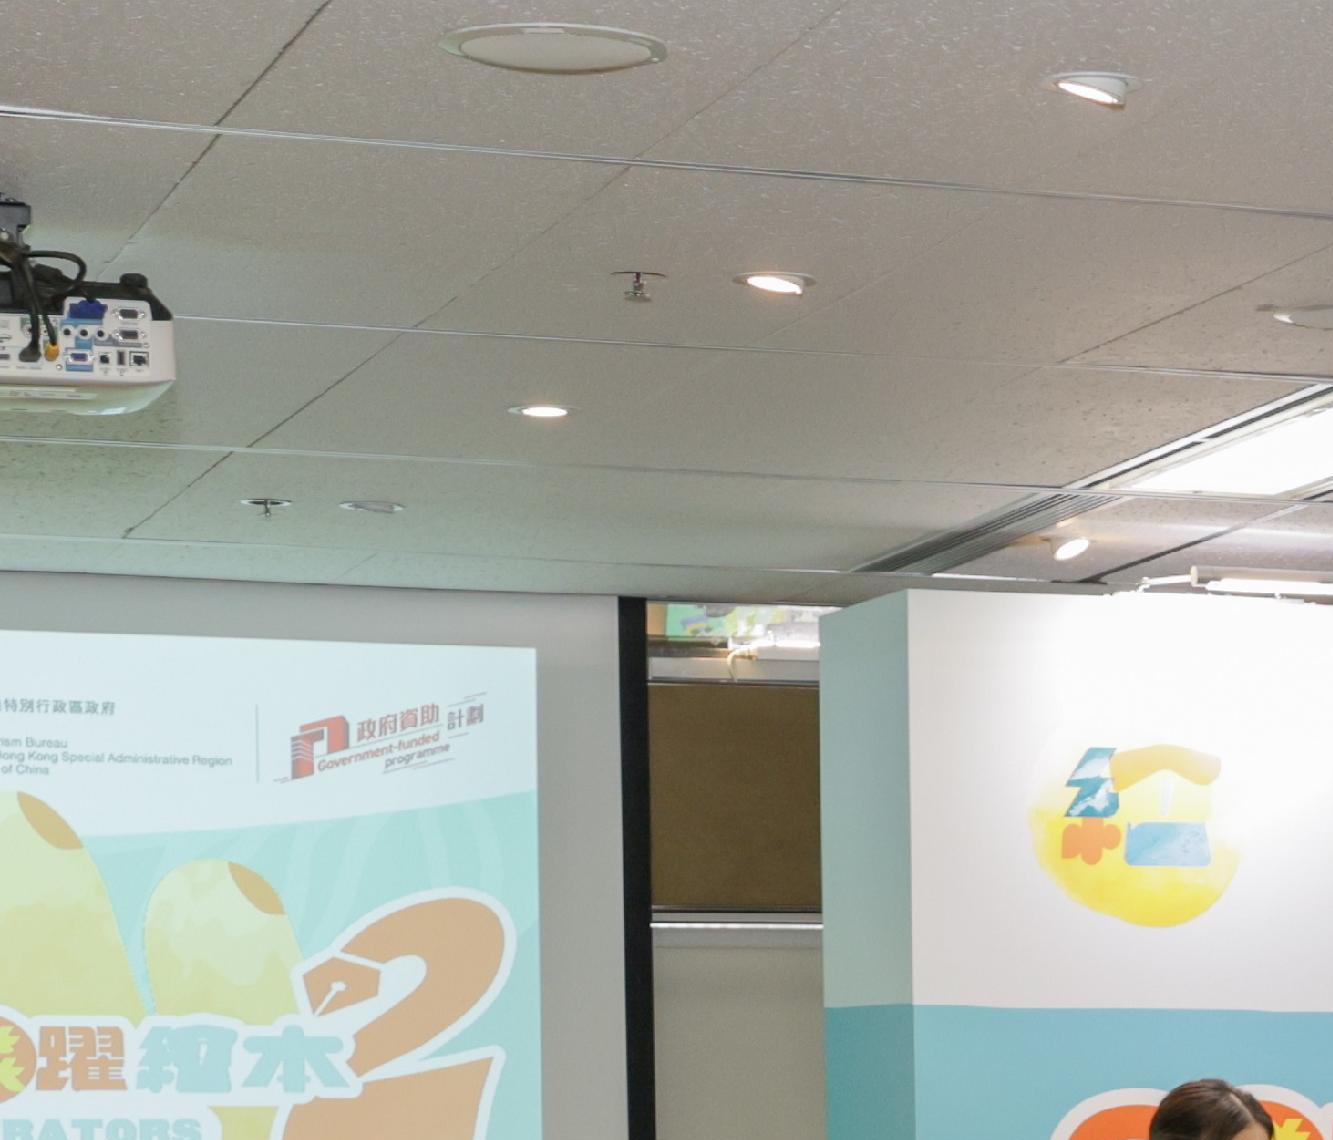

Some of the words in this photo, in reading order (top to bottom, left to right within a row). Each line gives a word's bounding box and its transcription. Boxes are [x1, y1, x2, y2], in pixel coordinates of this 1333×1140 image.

[0, 697, 116, 716] 特別行政區政府
[356, 703, 439, 742] 政府資助
[25, 737, 68, 749] Bureau
[318, 731, 440, 772] Government-funded
[0, 751, 25, 763] ong
[27, 751, 58, 764] Kong
[61, 752, 105, 764] Special
[107, 754, 190, 766] Administrative
[191, 755, 233, 768] Region
[1, 764, 15, 775] of
[15, 764, 50, 776] China
